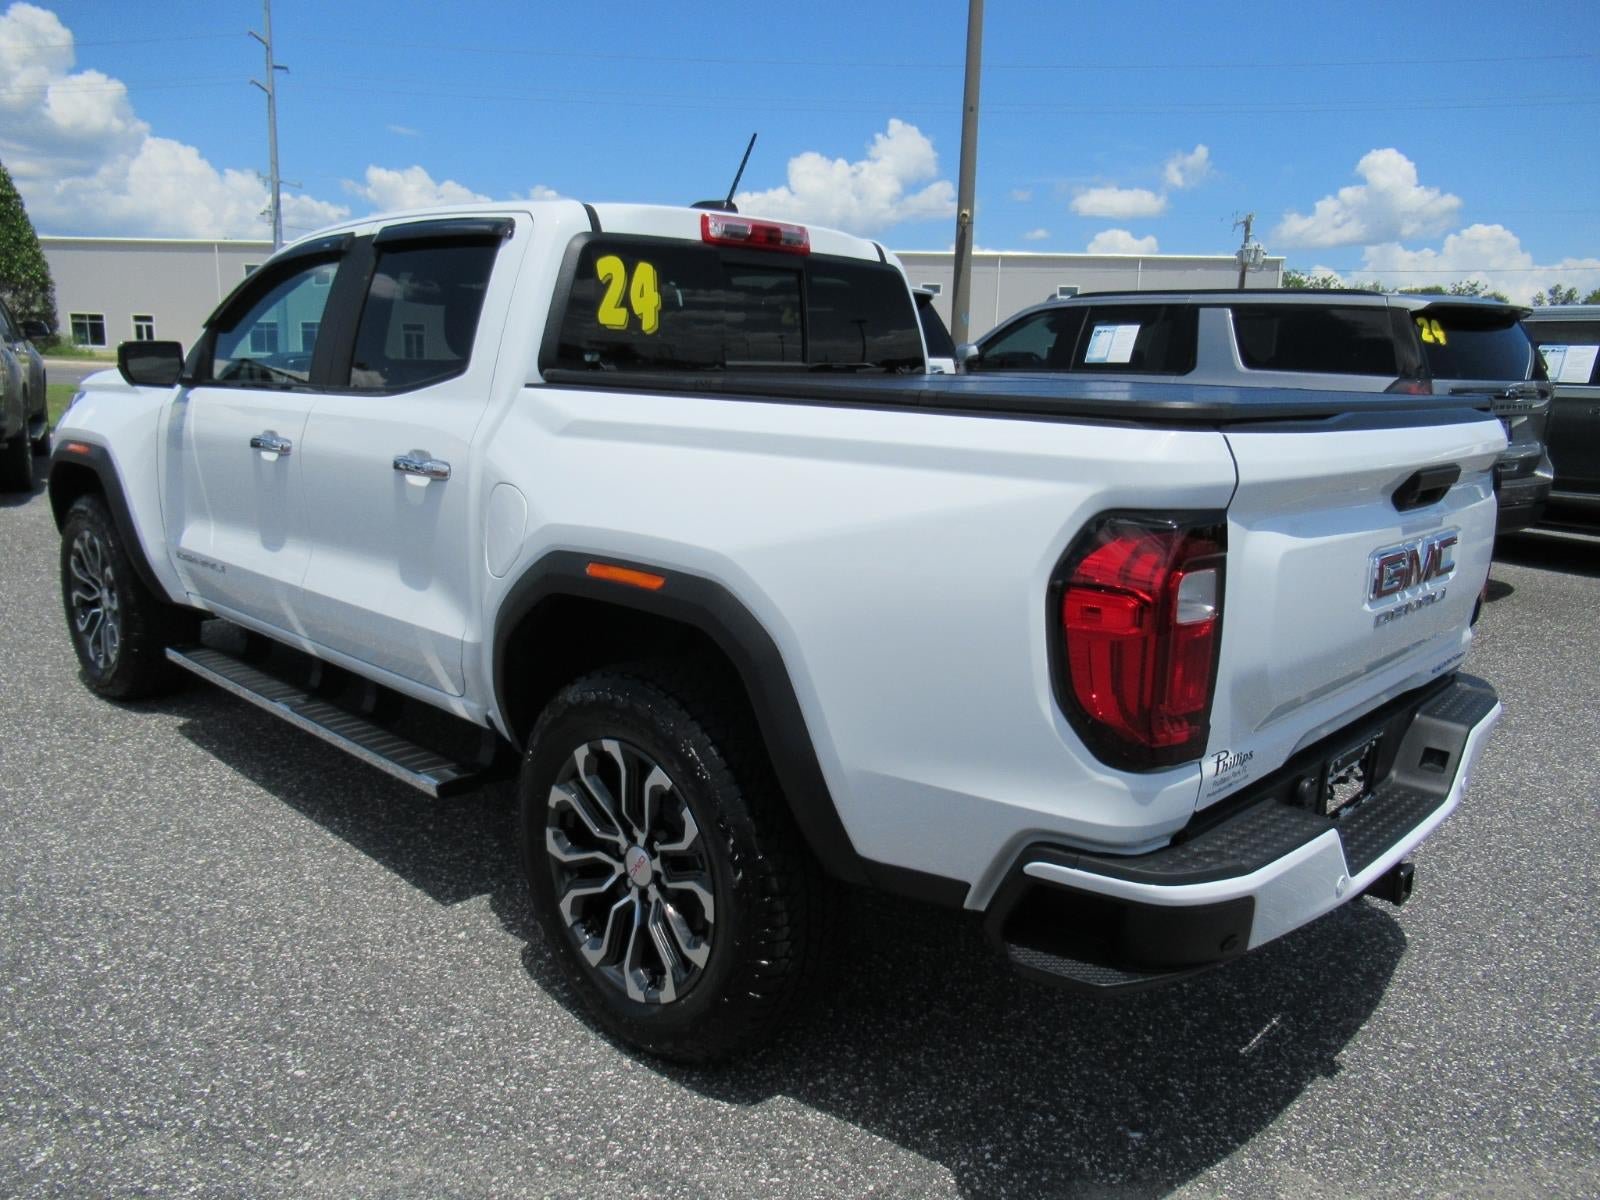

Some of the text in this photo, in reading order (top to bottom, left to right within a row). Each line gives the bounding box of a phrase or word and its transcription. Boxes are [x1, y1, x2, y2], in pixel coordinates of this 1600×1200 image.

[596, 255, 661, 335] 24
[1415, 317, 1447, 346] 24
[1367, 529, 1458, 604] GMC
[1211, 750, 1254, 777] Phillips
